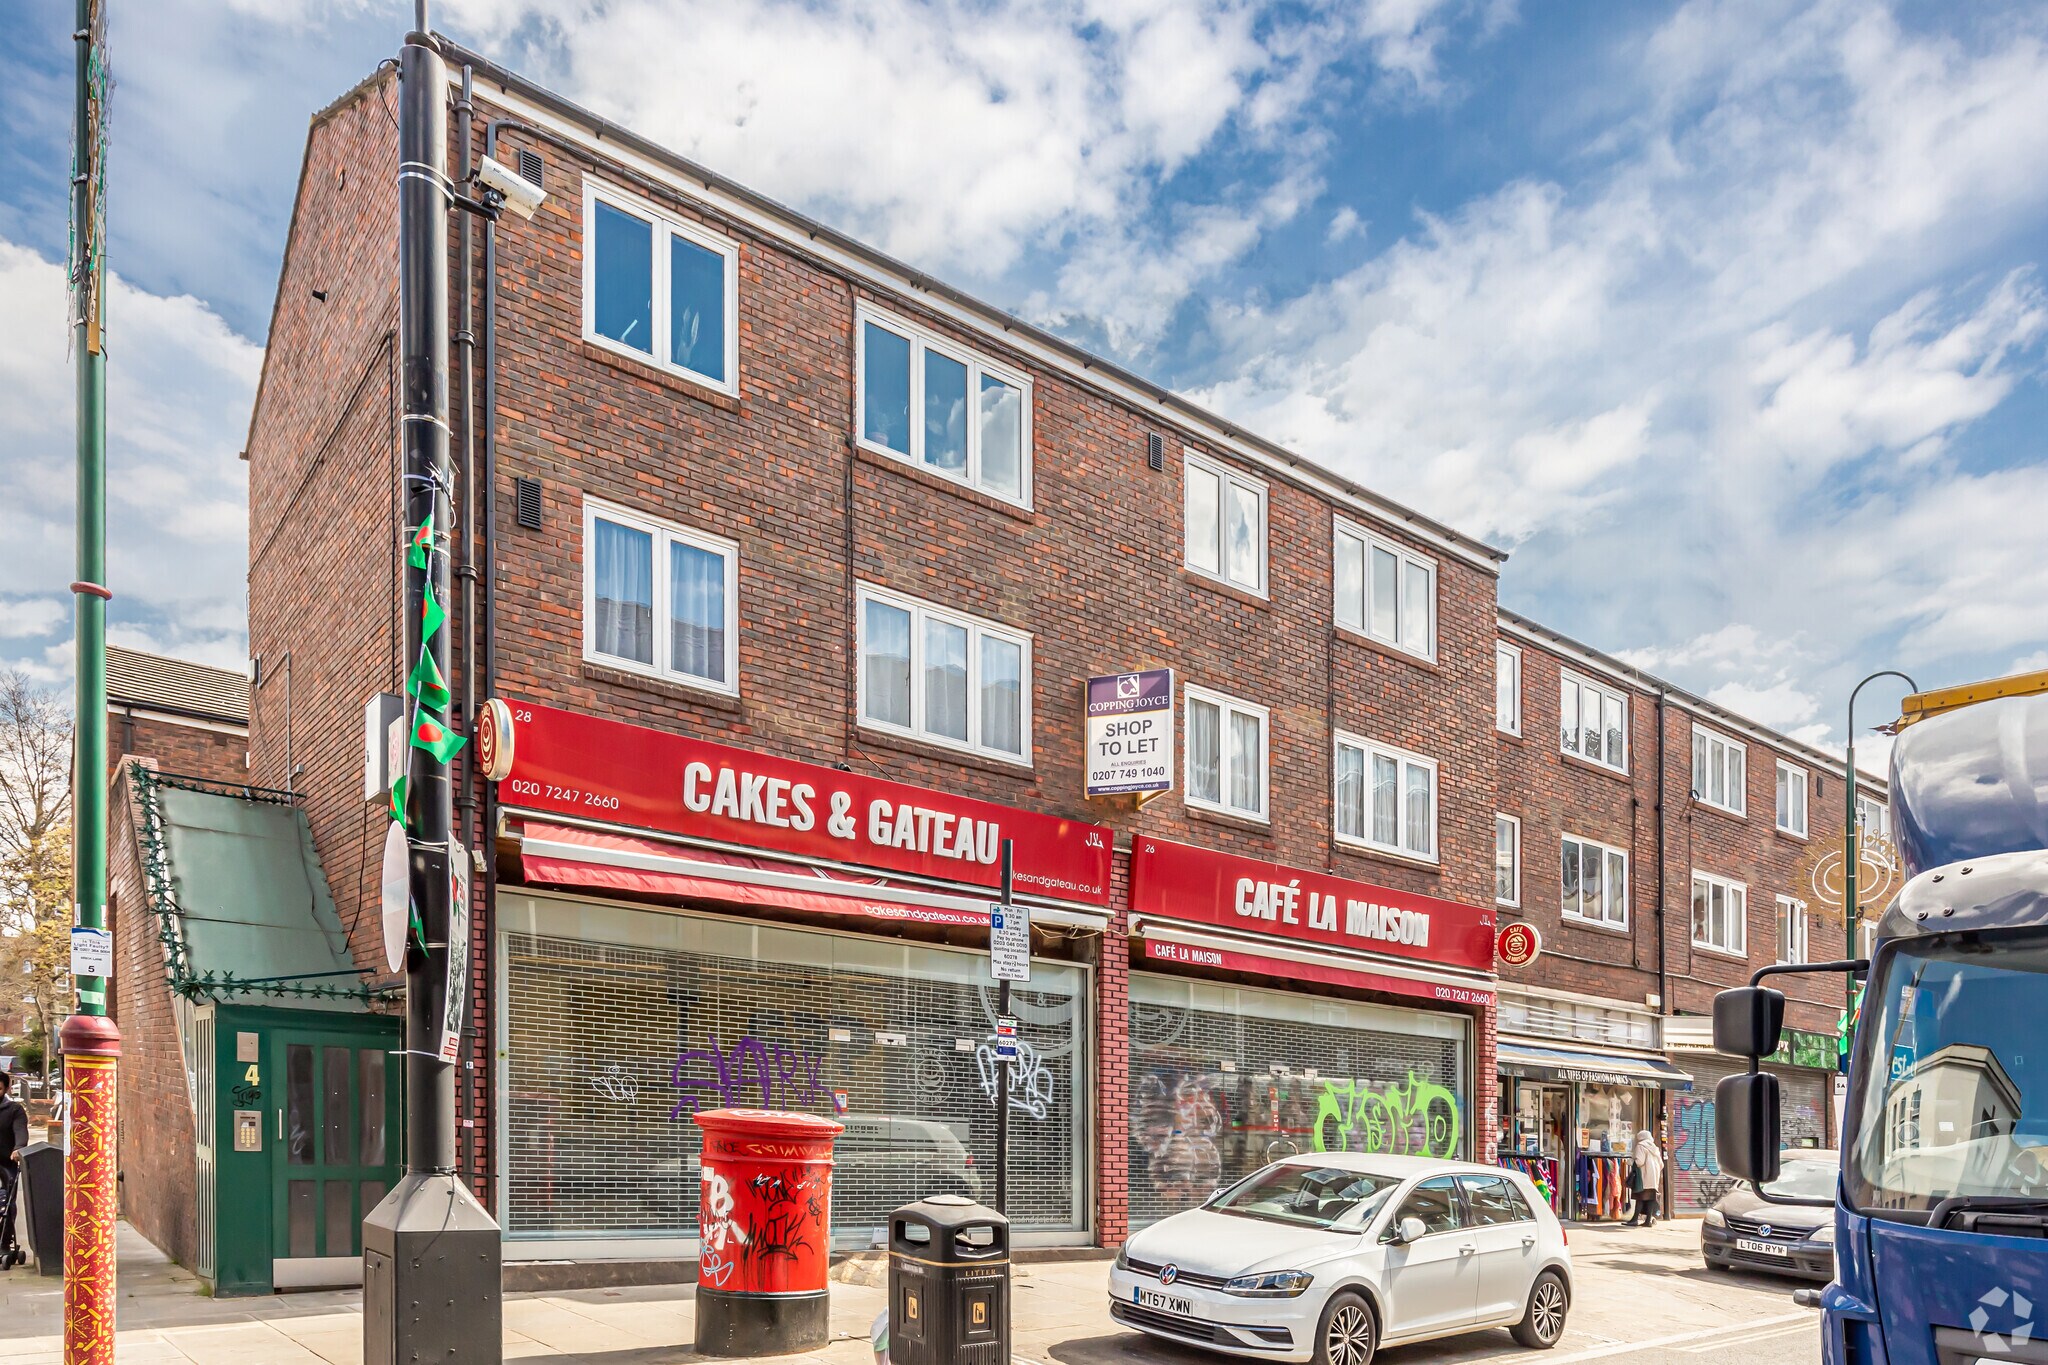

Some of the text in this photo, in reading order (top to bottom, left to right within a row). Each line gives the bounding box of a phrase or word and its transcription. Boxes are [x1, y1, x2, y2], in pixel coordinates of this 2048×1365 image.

[1089, 695, 1168, 712] COPPING JOYCE
[515, 709, 532, 722] 28
[1105, 720, 1152, 737] SHOP
[1099, 738, 1158, 756] TO LET
[1121, 759, 1147, 767] ENQUIRIES
[1092, 766, 1165, 781] 0207 749 1040
[512, 779, 619, 810] 020 7247 2660
[1098, 782, 1159, 792] www.coppingjoyce.co.uk
[683, 762, 999, 865] CAKES & GATEAU
[1145, 844, 1155, 854] 26
[1000, 869, 1102, 896] kesandgateau.co.uk
[994, 915, 1002, 927] P
[1235, 877, 1430, 948] CAFÉ LA MAISON
[1155, 942, 1222, 965] CAFÉ LA MAISON
[88, 965, 95, 973] 5
[1435, 986, 1490, 1005] 020 7247 2660
[244, 1064, 260, 1086] 4
[1557, 1069, 1629, 1085] ALL TYPES OF FASHION FABRICS
[1740, 1240, 1784, 1254] LT06 RYW
[965, 1269, 996, 1277] LITTER
[1139, 1289, 1190, 1315] MT67 XWN
